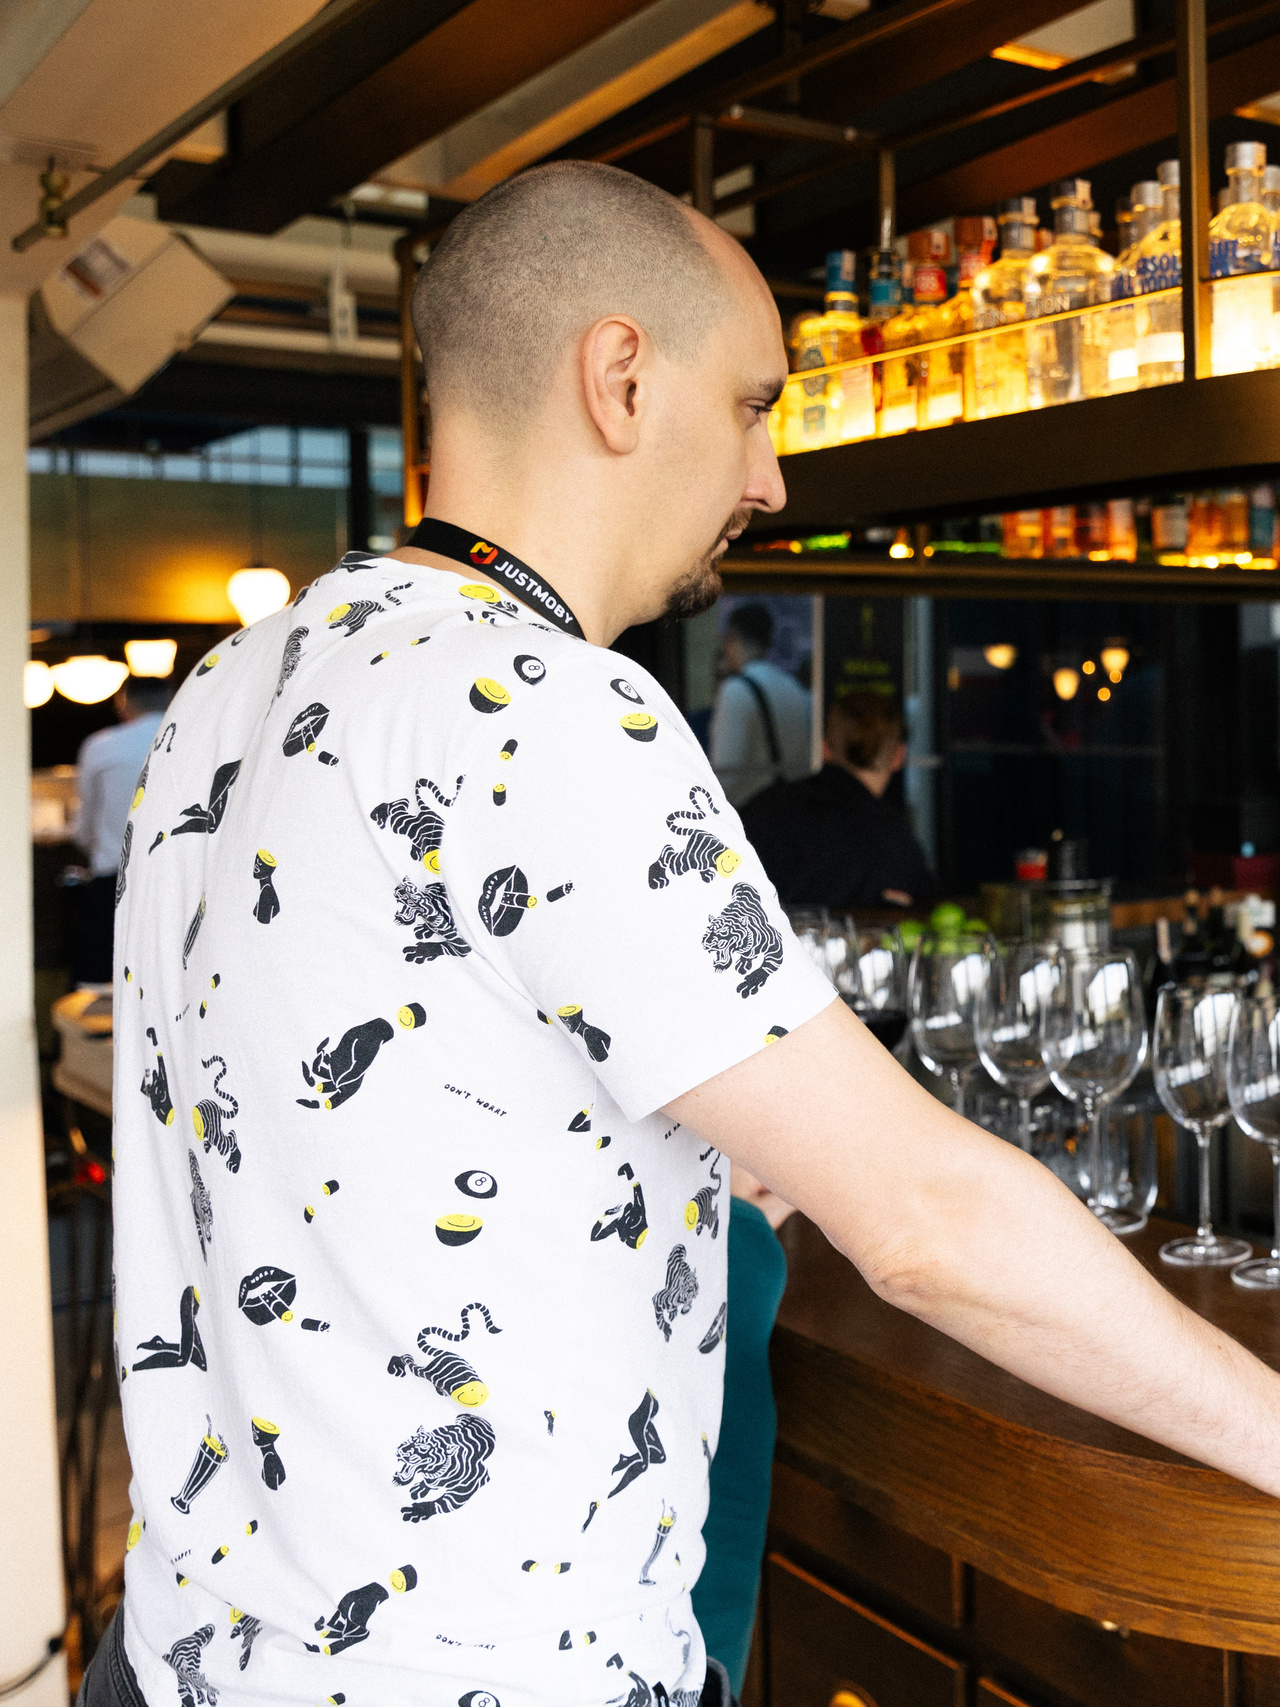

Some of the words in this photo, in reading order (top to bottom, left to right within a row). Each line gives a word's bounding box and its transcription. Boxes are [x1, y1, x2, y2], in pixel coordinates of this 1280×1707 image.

[494, 560, 574, 625] JUSTMOBY
[443, 1083, 472, 1099] DON'T
[475, 1097, 508, 1117] WORRY
